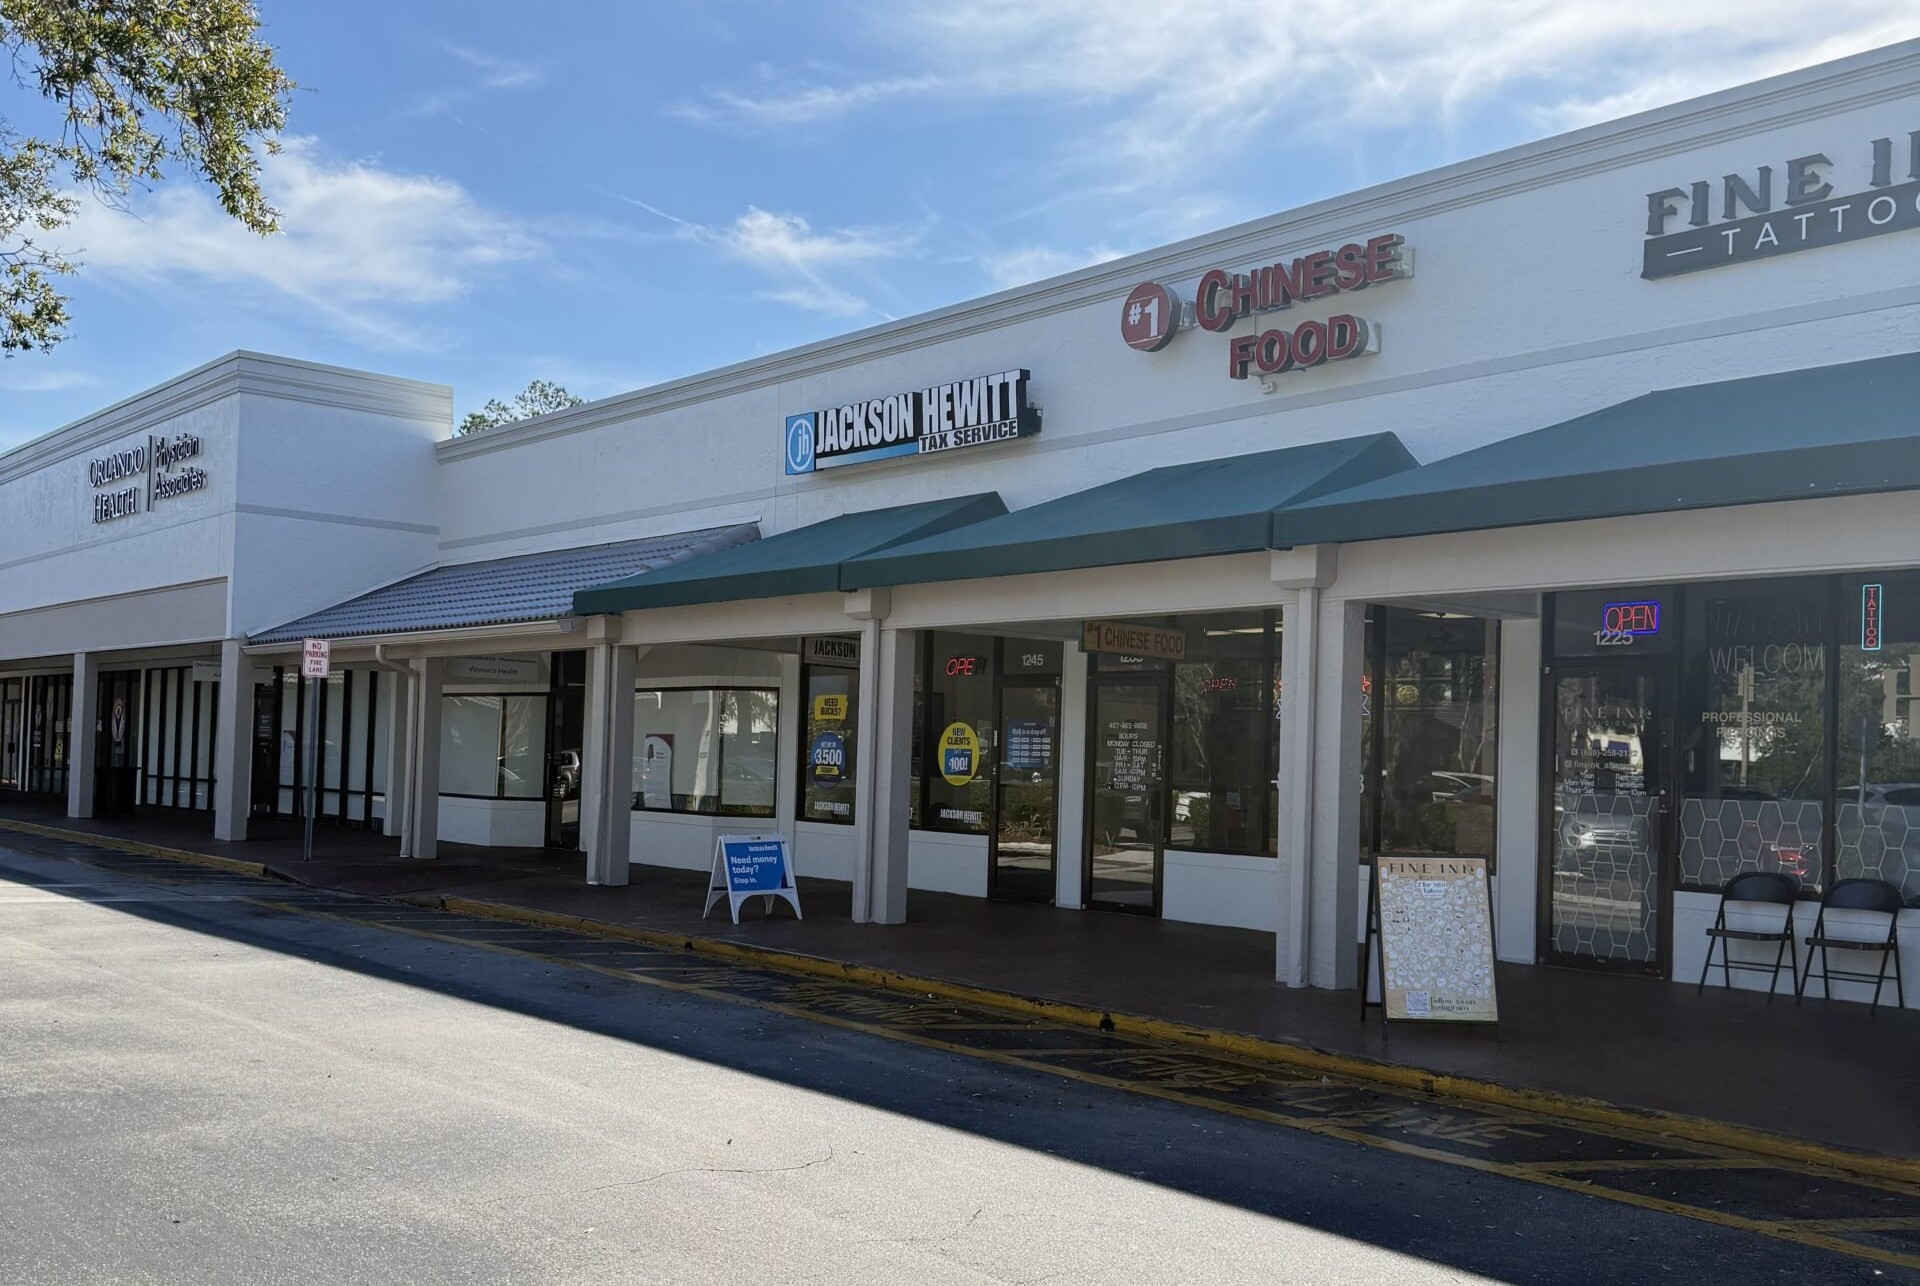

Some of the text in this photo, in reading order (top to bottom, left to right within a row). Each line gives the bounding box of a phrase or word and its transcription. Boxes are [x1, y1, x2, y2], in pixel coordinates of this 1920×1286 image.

[1646, 153, 1834, 236] FINE
[1721, 193, 1920, 255] TATTO
[1196, 234, 1397, 331] CHINESE
[1129, 297, 1159, 338] #1
[1230, 314, 1361, 379] FOOD
[816, 369, 1021, 454] JACKSON HEWITT
[920, 420, 1017, 452] TAX SERVICE
[156, 433, 200, 473] Physician
[88, 446, 145, 488] ORLANDO
[155, 467, 206, 500] Associates
[92, 487, 137, 524] HEALTH
[1605, 605, 1657, 631] OPEN
[1866, 588, 1877, 646] TATTOO
[312, 642, 322, 650] NO
[814, 639, 856, 658] JACKSON
[1105, 627, 1151, 650] CHINESE
[1155, 633, 1183, 653] FOOD
[1593, 629, 1634, 646] 1225
[305, 650, 328, 658] PARKING
[1022, 654, 1044, 666] 1245
[820, 707, 842, 716] BUCKS?
[824, 698, 839, 707] NEED
[1702, 712, 1802, 723] PROFESSIONAL
[947, 736, 971, 746] CLIENTS
[1716, 728, 1786, 739] PIERCINGS
[940, 808, 964, 820] JACKSON
[730, 855, 778, 864] Need money
[732, 864, 759, 874] today?
[1390, 863, 1431, 874] FINE
